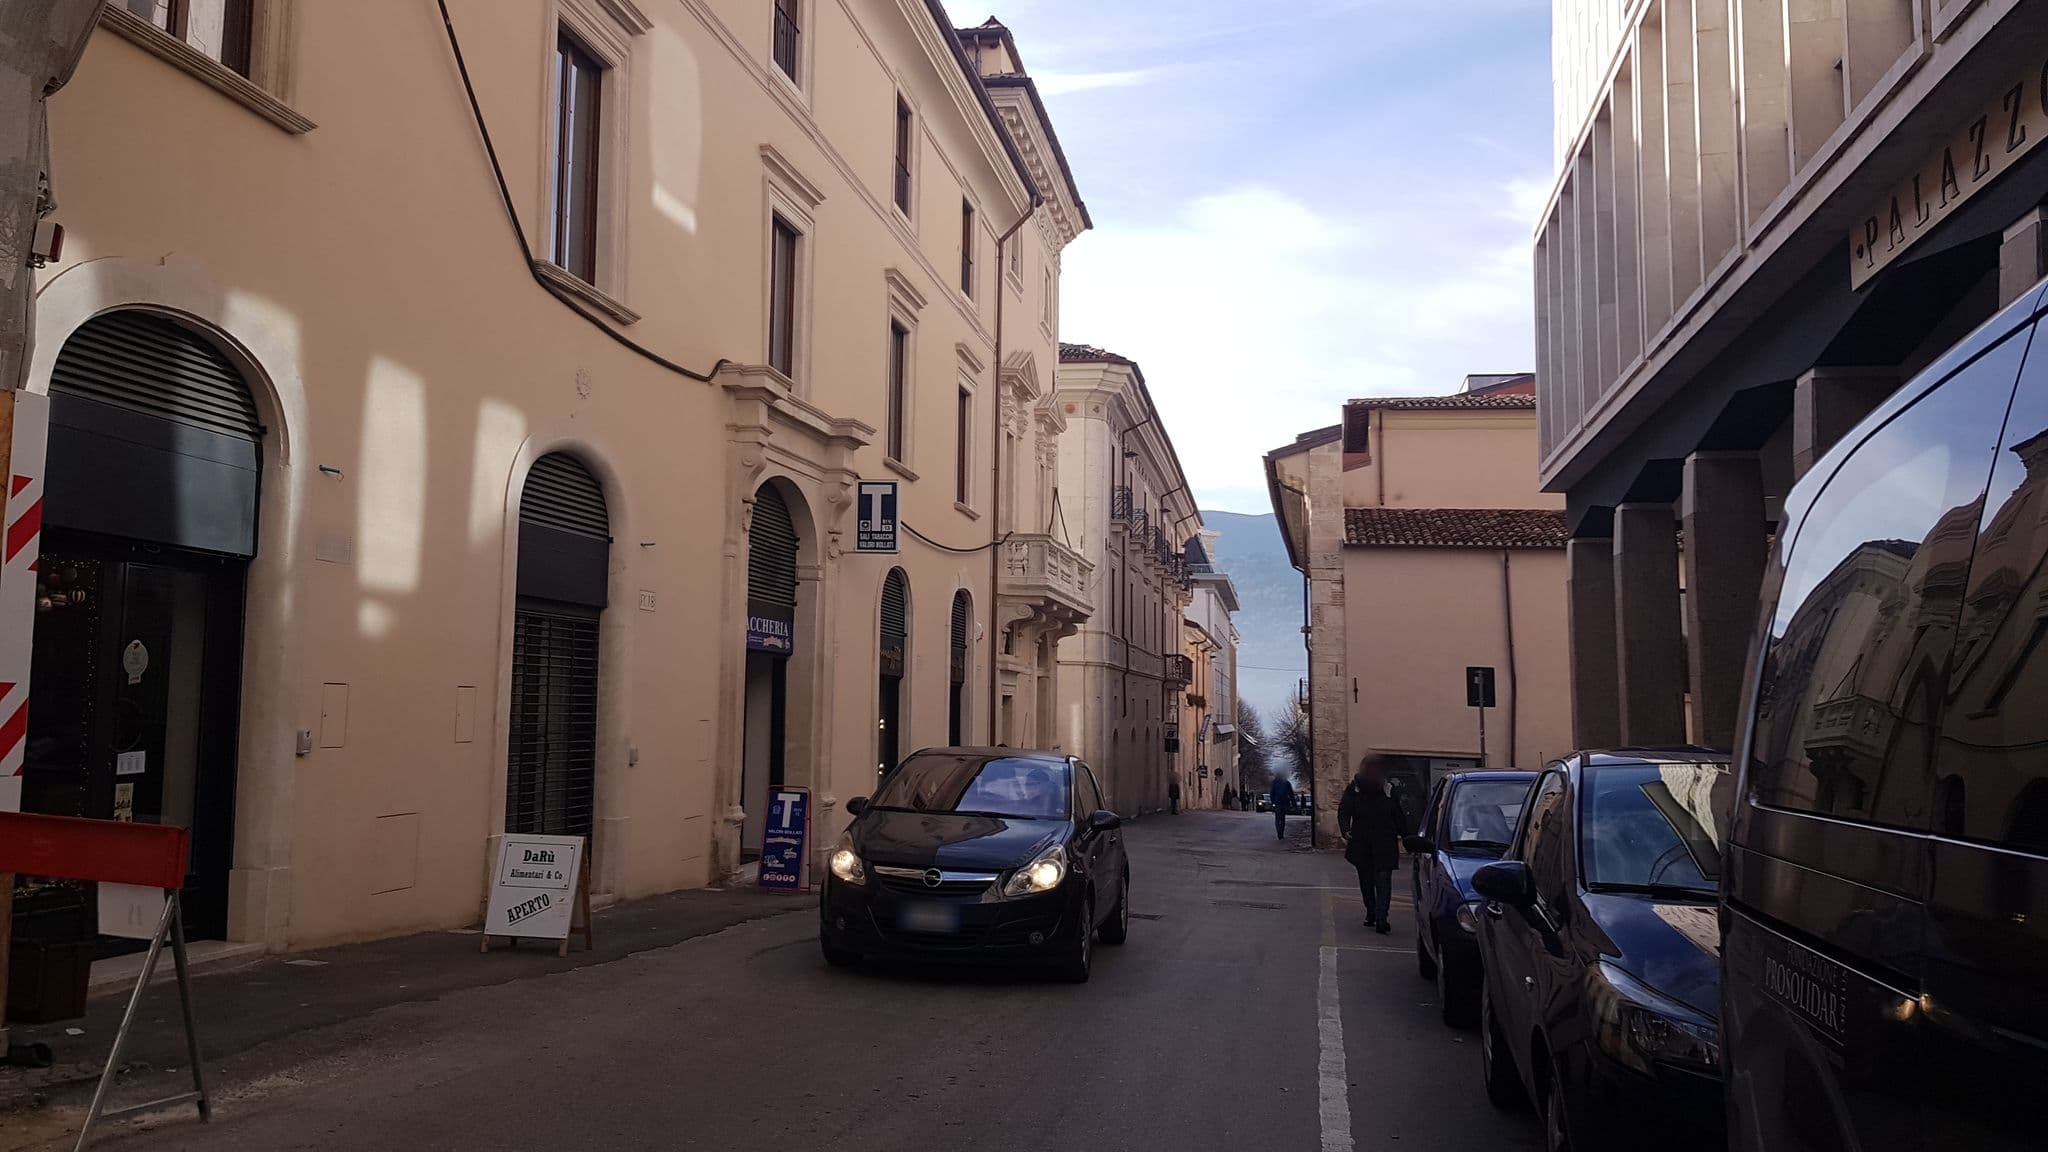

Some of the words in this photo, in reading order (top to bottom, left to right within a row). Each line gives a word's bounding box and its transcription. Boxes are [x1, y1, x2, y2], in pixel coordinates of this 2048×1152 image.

[1863, 59, 2048, 269] PALAZZ
[861, 484, 893, 532] T
[777, 792, 801, 828] T
[510, 869, 544, 879] Alimentari
[546, 870, 552, 879] &
[554, 870, 563, 880] Co
[523, 850, 555, 863] DaRù
[507, 893, 550, 923] APERTO
[1765, 956, 1840, 1032] PROSOLIDAR
